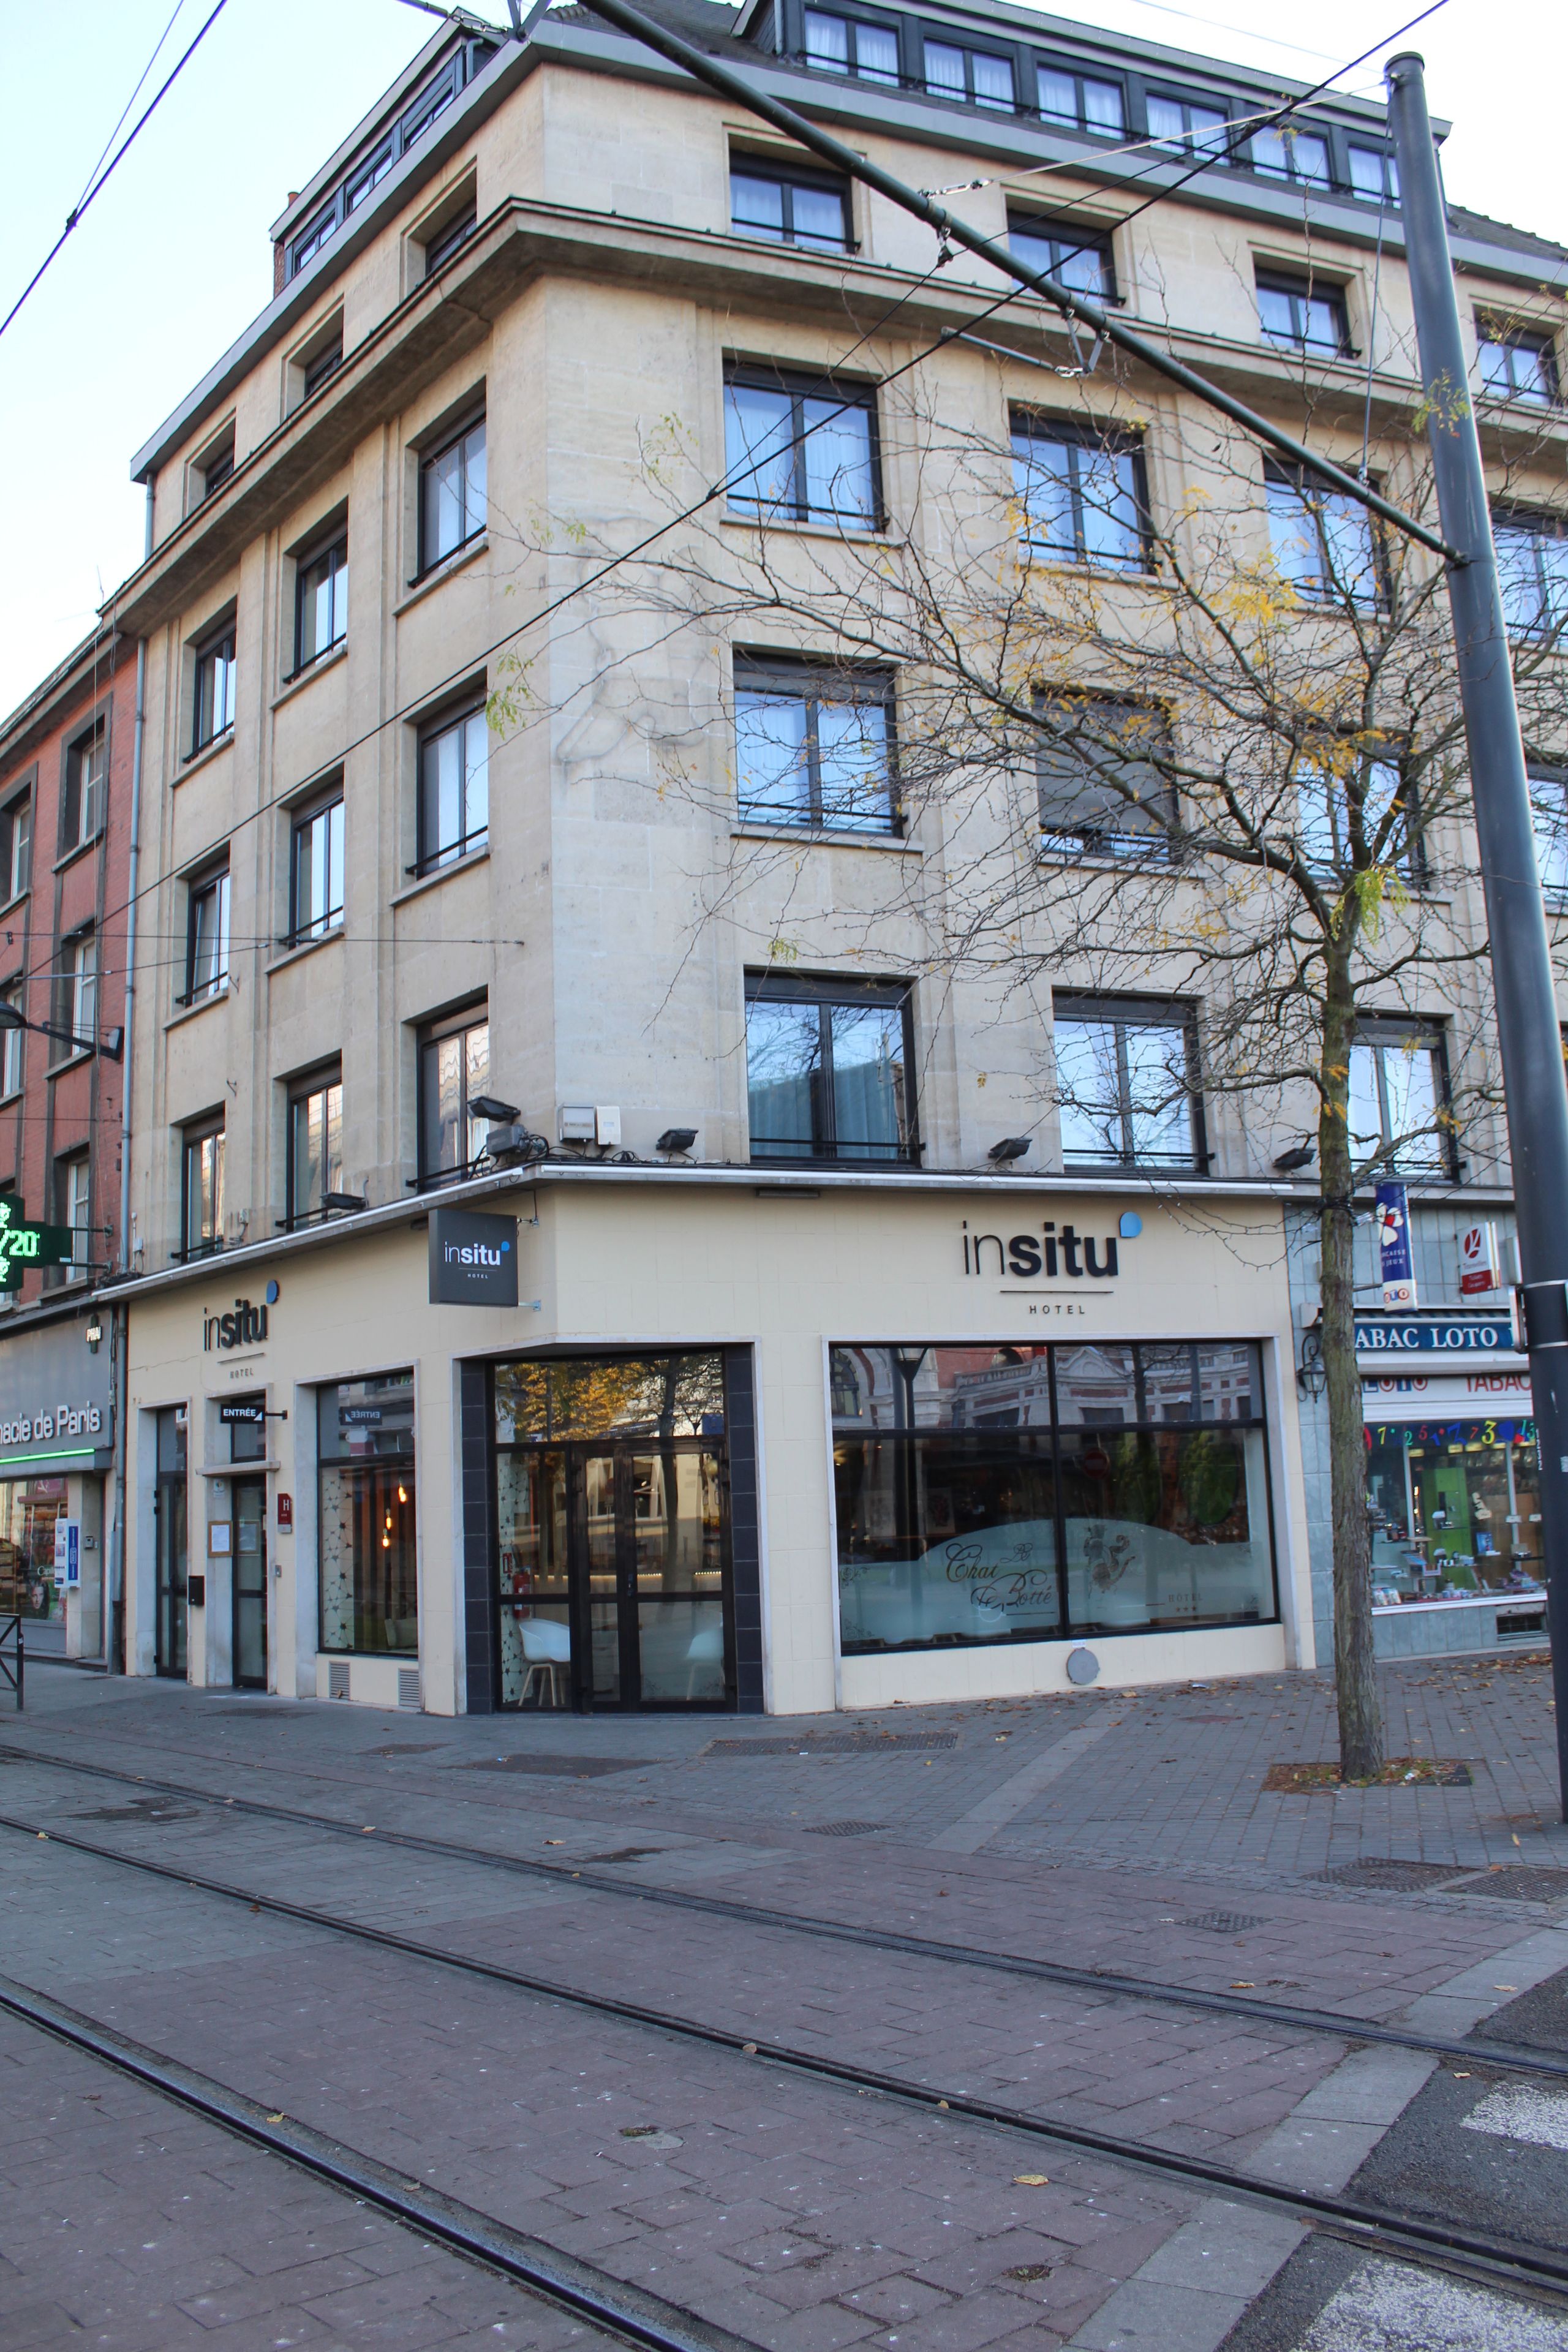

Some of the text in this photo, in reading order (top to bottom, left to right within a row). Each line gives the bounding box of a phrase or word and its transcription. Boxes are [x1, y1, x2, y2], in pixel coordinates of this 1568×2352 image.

[445, 1241, 500, 1265] insitu
[963, 1220, 1118, 1276] insitu
[1384, 1287, 1410, 1304] OTO
[1029, 1305, 1085, 1314] HOTEL
[204, 1298, 268, 1351] insitu
[1354, 1328, 1420, 1348] ABAC
[1430, 1327, 1499, 1348] LOTO
[230, 1367, 254, 1379] HOTEL
[1363, 1378, 1428, 1393] LOTO
[34, 1409, 54, 1439] de
[57, 1400, 101, 1436] Paris
[223, 1408, 257, 1417] ENTRÉE
[1481, 1420, 1497, 1444] 3
[283, 1499, 290, 1511] H
